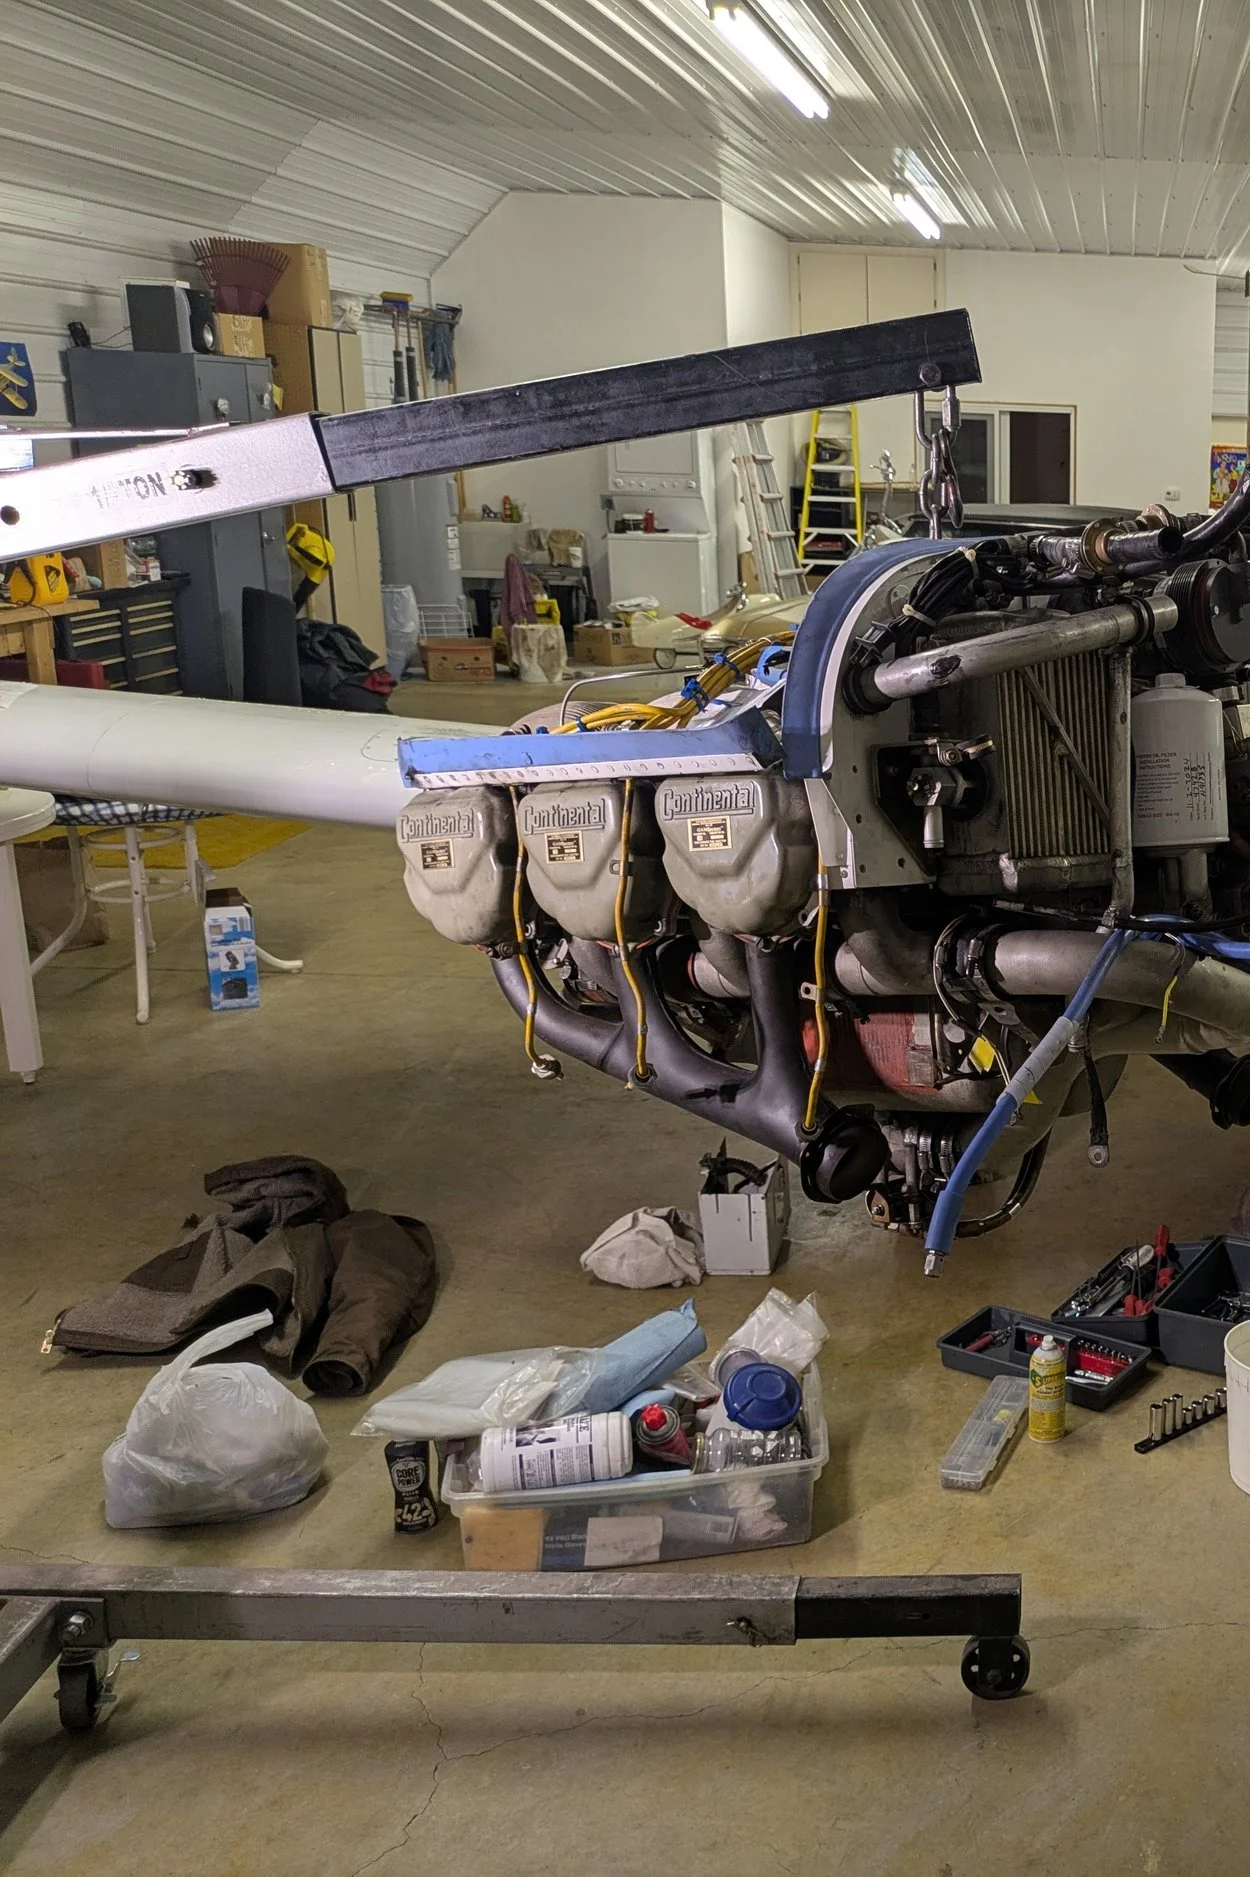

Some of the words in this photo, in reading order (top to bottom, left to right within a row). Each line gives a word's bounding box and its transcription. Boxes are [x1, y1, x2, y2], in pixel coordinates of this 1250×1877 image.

[524, 797, 607, 836] Continental
[663, 780, 756, 821] Continental
[401, 808, 475, 843] Continental
[396, 1466, 419, 1478] CORE
[397, 1476, 421, 1487] POWER
